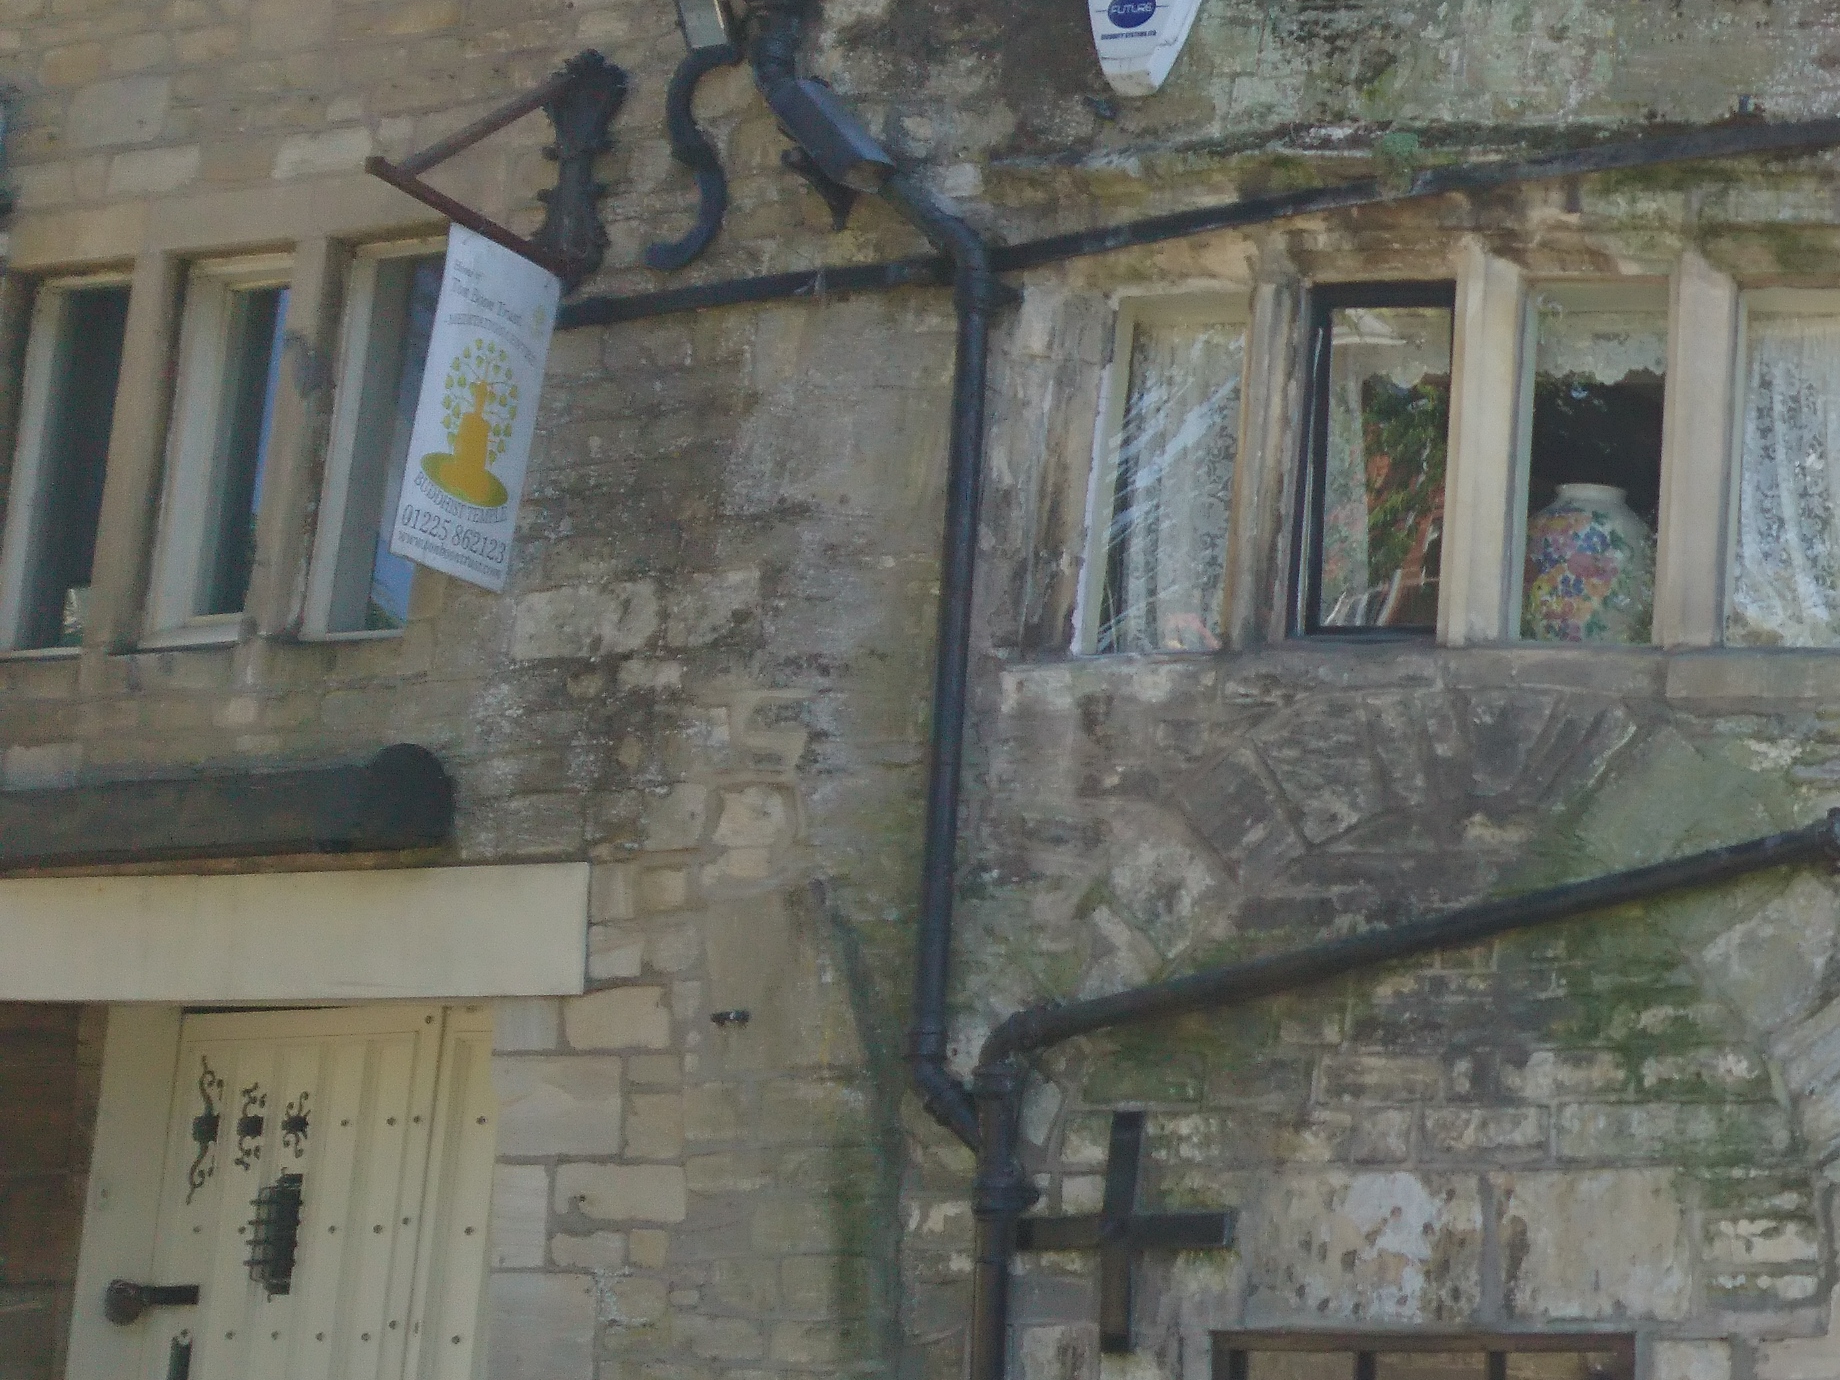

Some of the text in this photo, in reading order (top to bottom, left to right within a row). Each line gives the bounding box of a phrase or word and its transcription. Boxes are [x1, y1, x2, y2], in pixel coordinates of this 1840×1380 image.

[1111, 2, 1153, 14] FUTURE
[401, 504, 507, 564] 01225 862123
